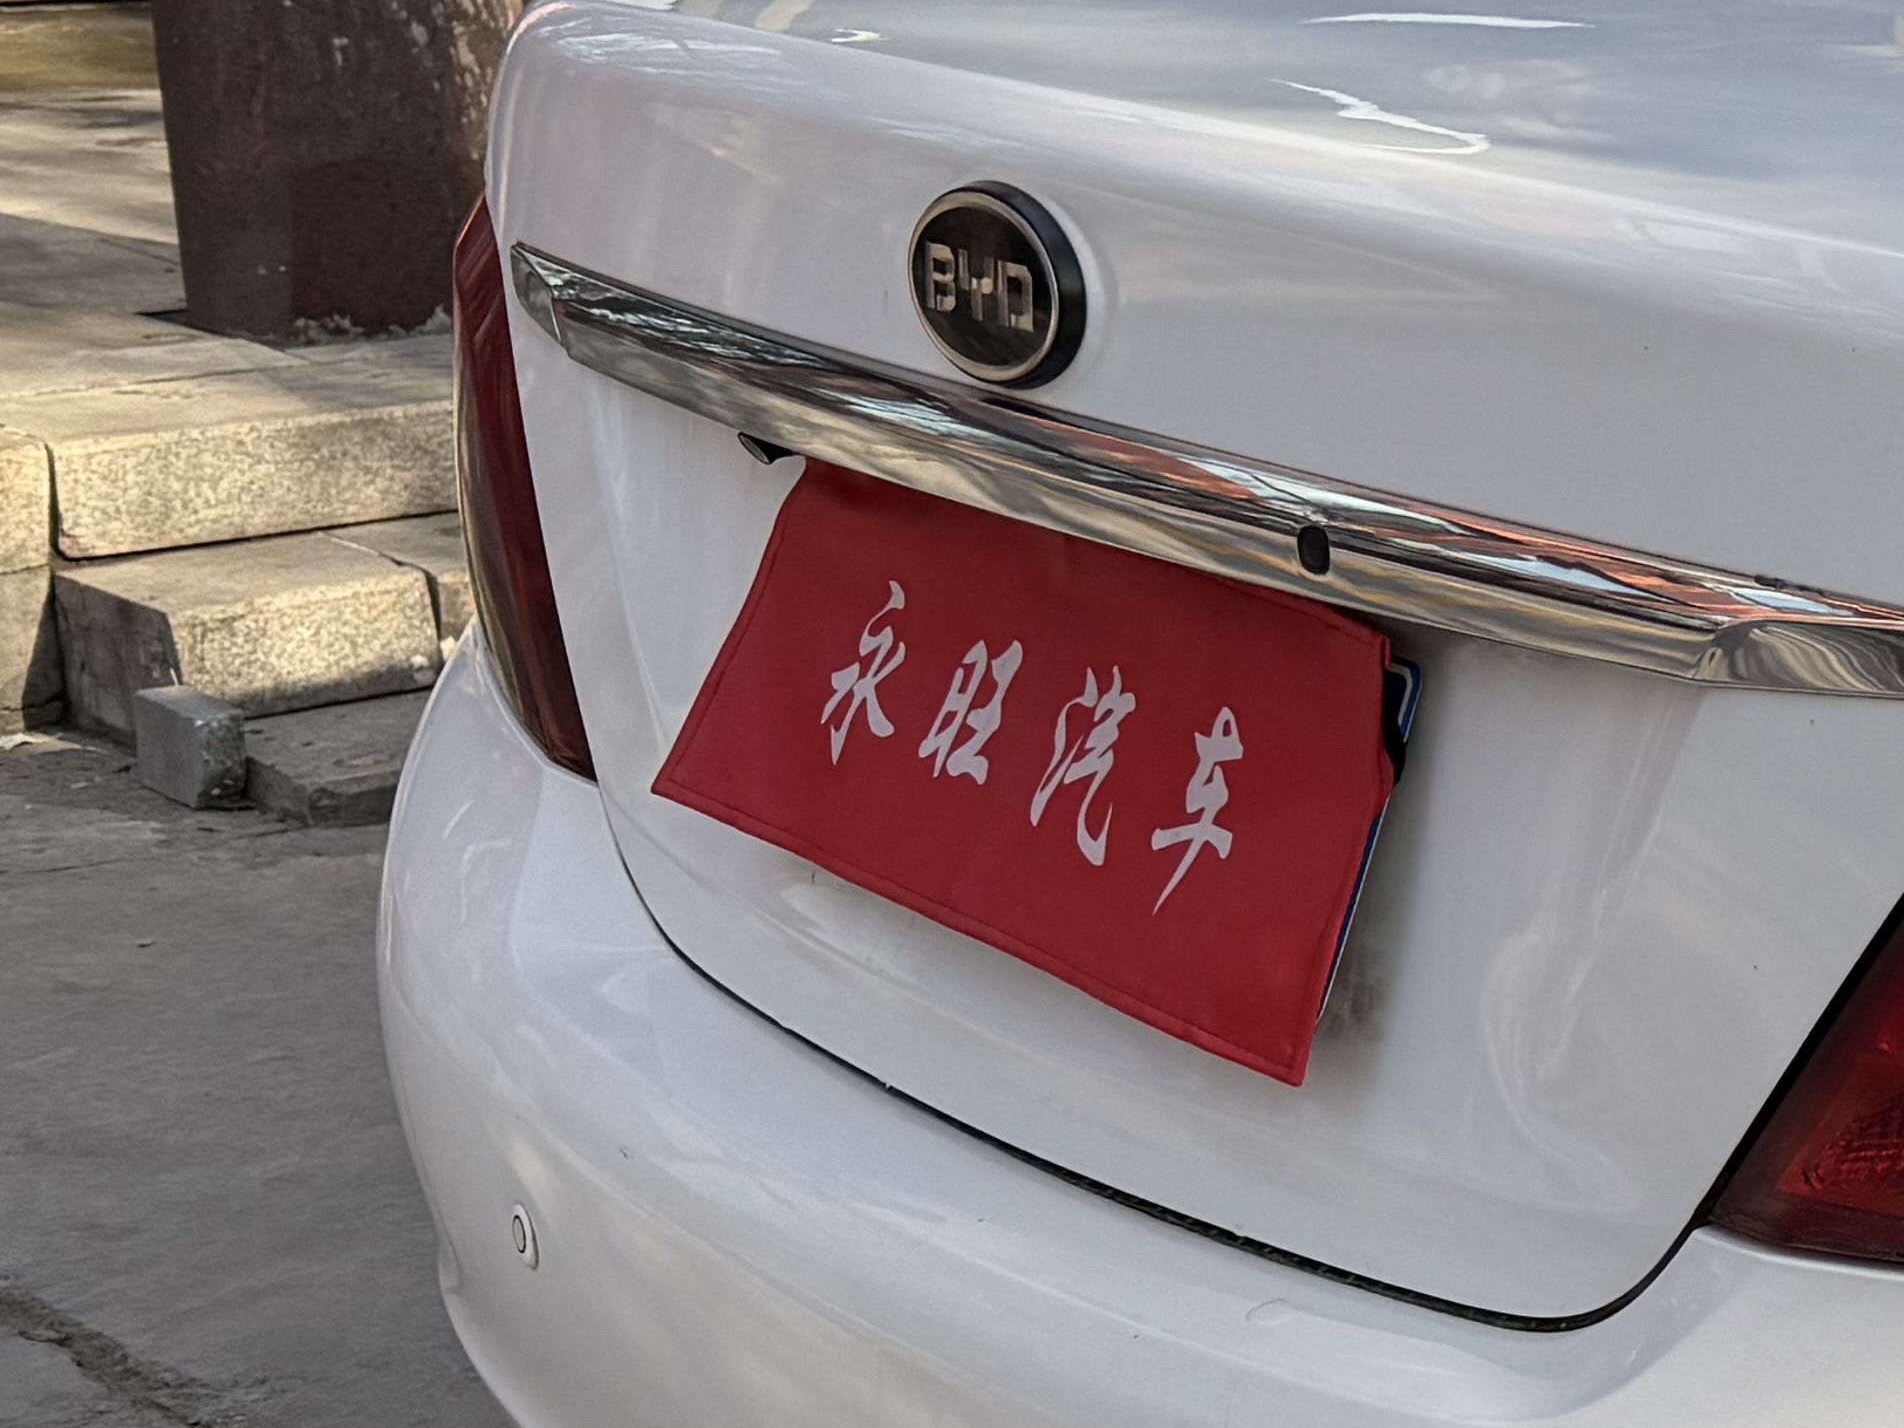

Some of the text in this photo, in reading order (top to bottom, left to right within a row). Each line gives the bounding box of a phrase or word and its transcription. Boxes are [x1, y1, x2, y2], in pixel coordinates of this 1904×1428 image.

[924, 241, 1035, 334] BYD
[820, 579, 1245, 917] 永旺汽车
